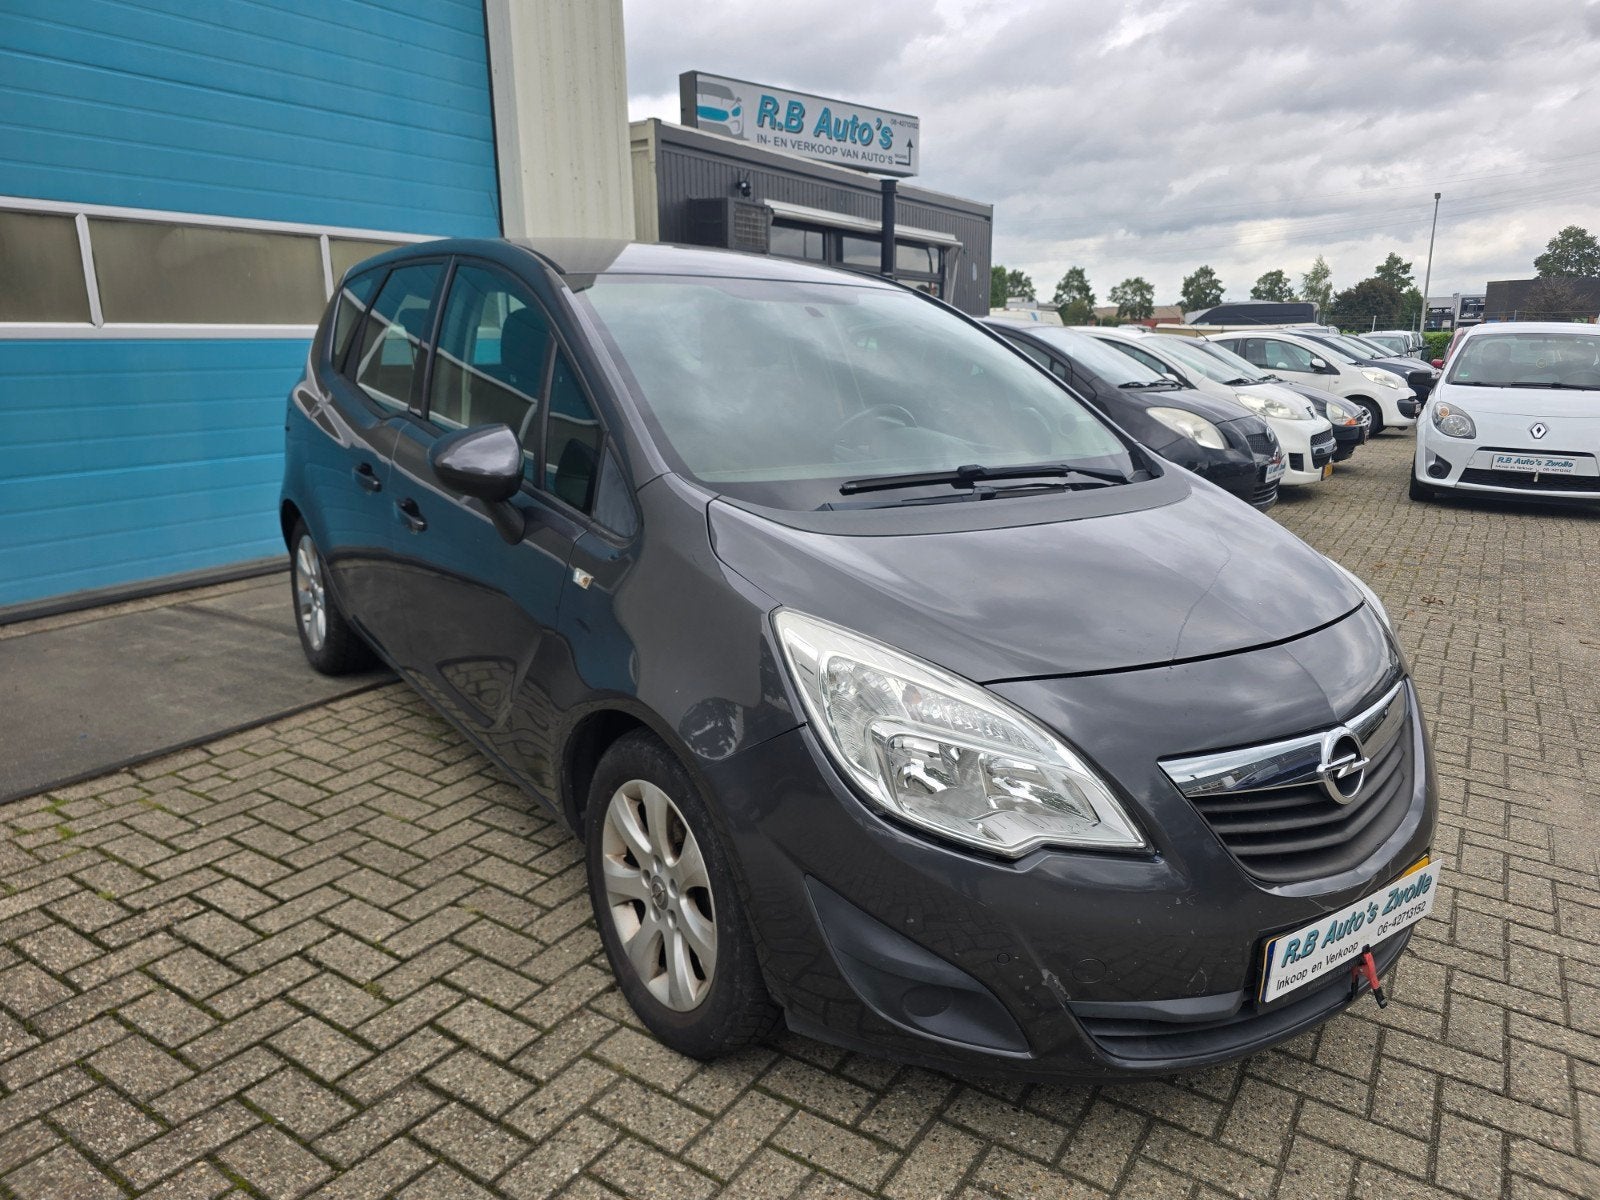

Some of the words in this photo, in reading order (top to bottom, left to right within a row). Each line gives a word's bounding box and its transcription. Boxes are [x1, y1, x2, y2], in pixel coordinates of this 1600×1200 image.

[756, 94, 806, 134] R.B
[813, 107, 894, 150] Auto's
[757, 133, 771, 145] IN-
[773, 137, 788, 148] EN
[790, 139, 838, 156] VERKOOP
[839, 148, 859, 160] VAN
[861, 151, 894, 165] AUTO'S
[1497, 456, 1513, 464] R.B
[1514, 458, 1542, 466] Auto's
[1544, 460, 1574, 468] Zwolle
[1281, 929, 1319, 968] R.B
[1321, 902, 1379, 949] Auto's
[1381, 873, 1433, 916] Zwolle
[1377, 901, 1426, 937] 06-42713152
[1276, 968, 1308, 991] Inkoop
[1311, 962, 1322, 973] en
[1325, 941, 1359, 965] Verkoop
